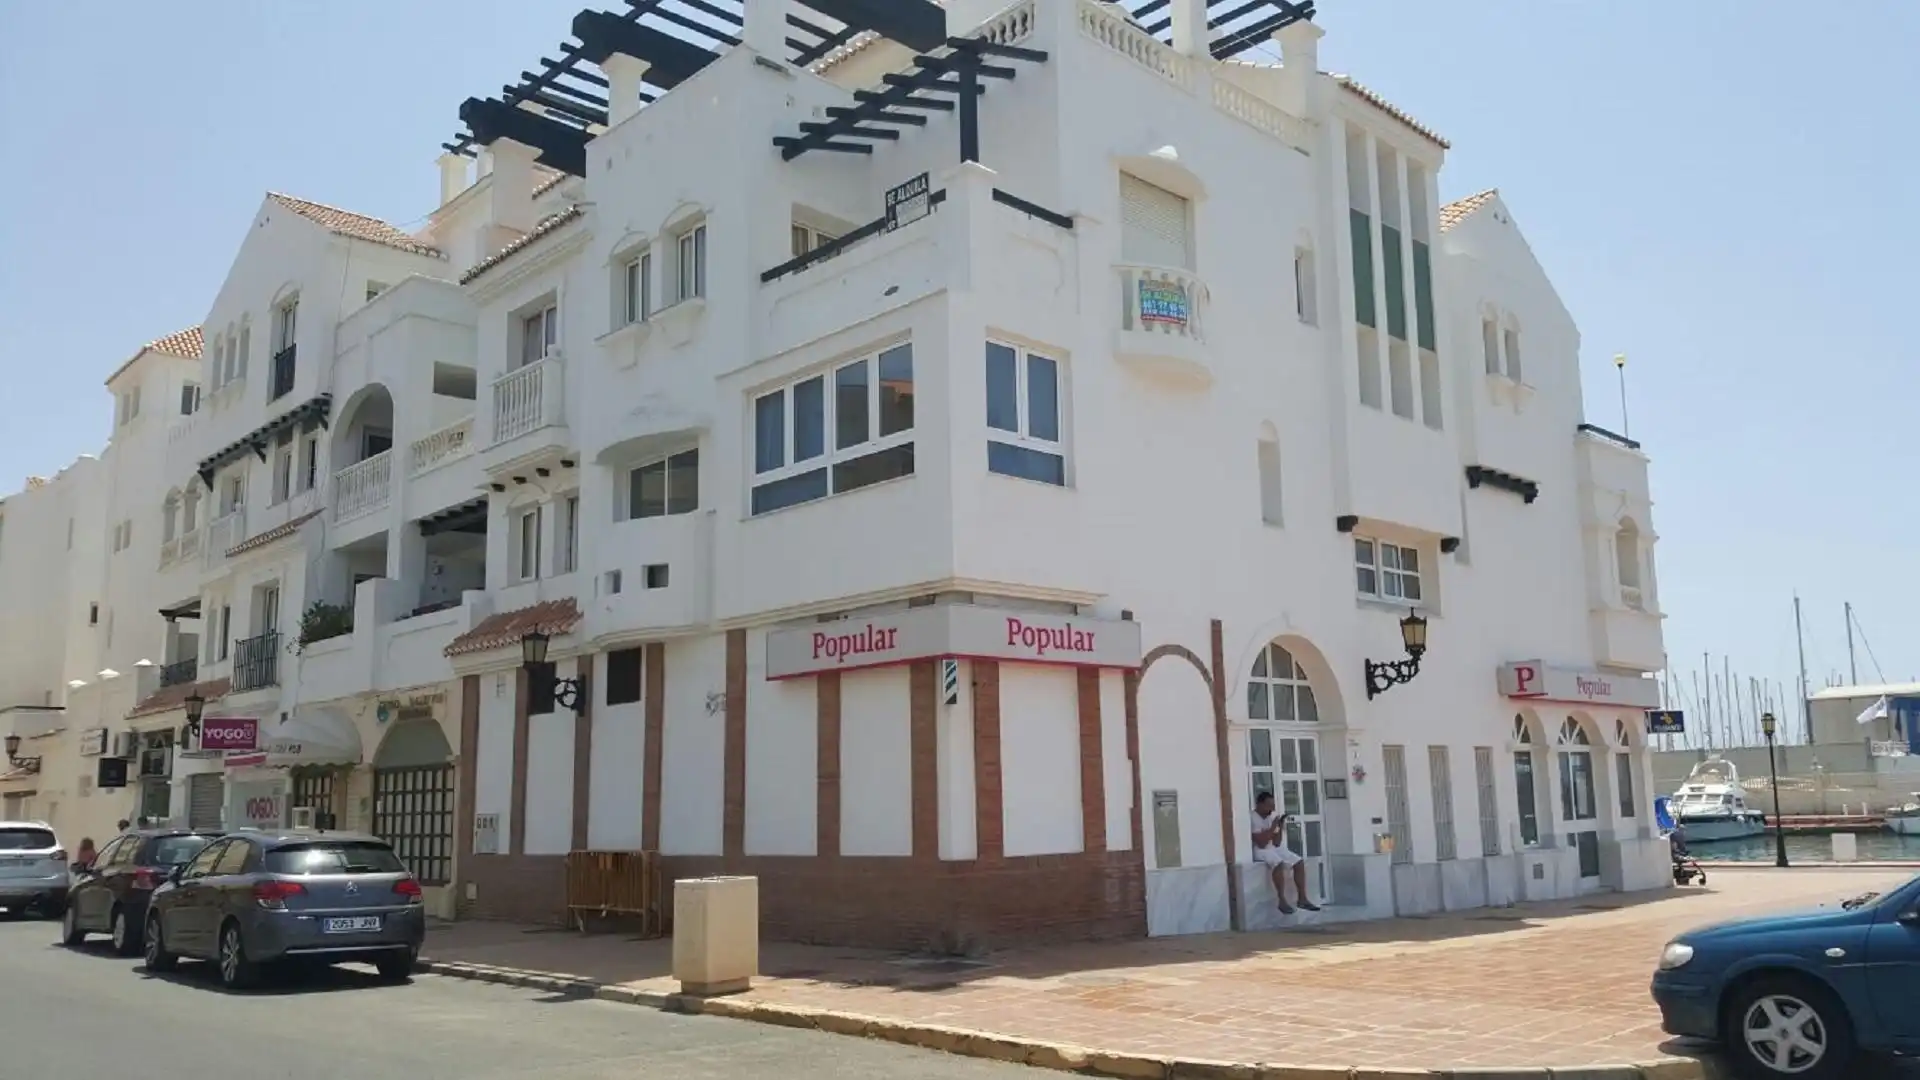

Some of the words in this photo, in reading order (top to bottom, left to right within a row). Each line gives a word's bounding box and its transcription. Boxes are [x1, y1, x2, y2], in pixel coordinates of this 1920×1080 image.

[812, 623, 898, 662] Popular
[1006, 617, 1095, 655] Popular
[1514, 666, 1535, 693] P
[1576, 675, 1612, 699] Popular
